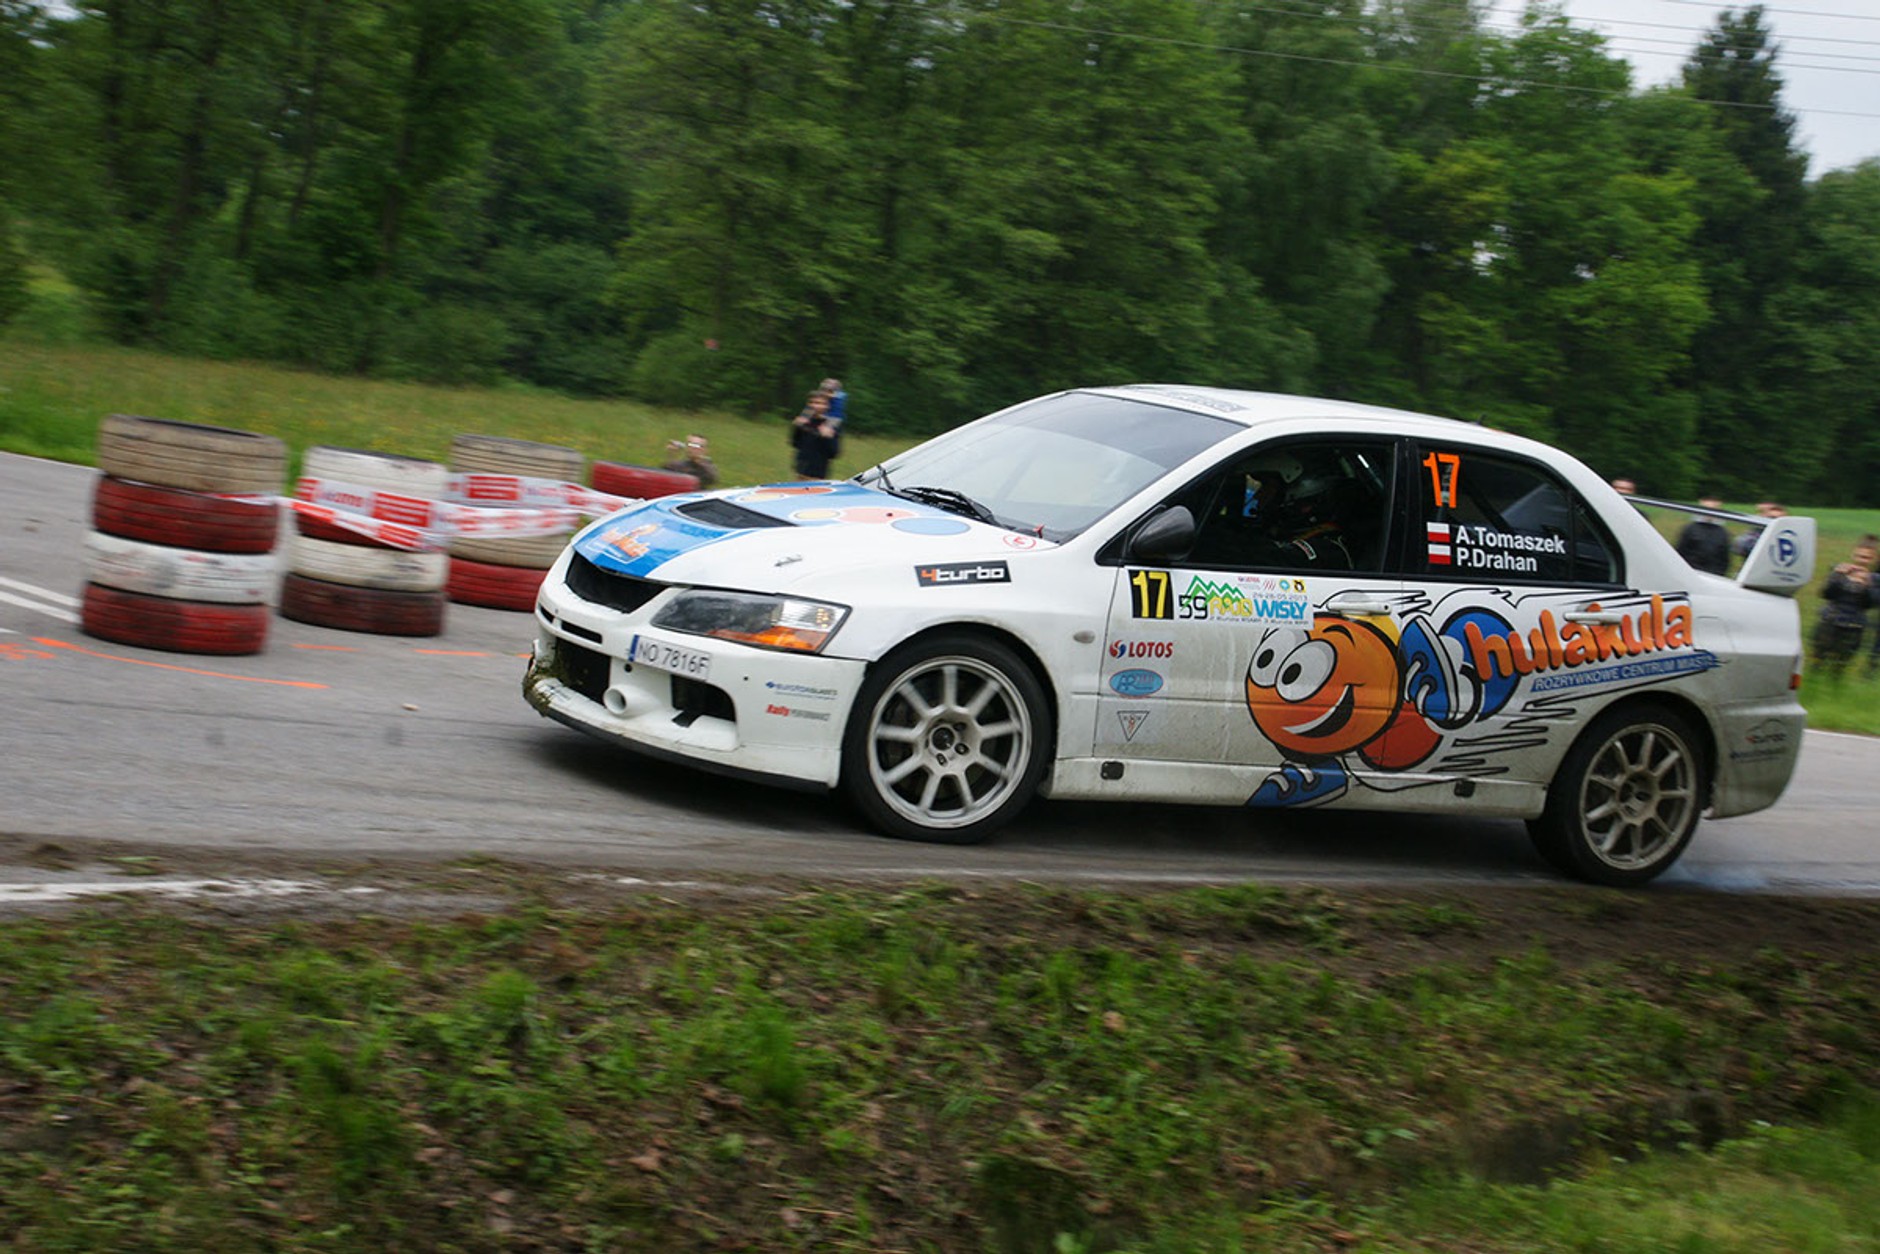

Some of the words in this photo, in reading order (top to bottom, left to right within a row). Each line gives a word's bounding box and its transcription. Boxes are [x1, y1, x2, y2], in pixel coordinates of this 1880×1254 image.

[1422, 451, 1461, 509] 17
[1455, 525, 1567, 554] A.Tomaszek
[1456, 546, 1538, 572] P.Drahan
[921, 566, 1005, 582] 4turbo
[1132, 570, 1169, 619] 17
[1178, 594, 1209, 619] 59
[1128, 641, 1174, 658] LOTOS
[1464, 593, 1693, 681] hulakula
[638, 641, 660, 663] NO
[1534, 667, 1620, 691] ROZRYWKOWE
